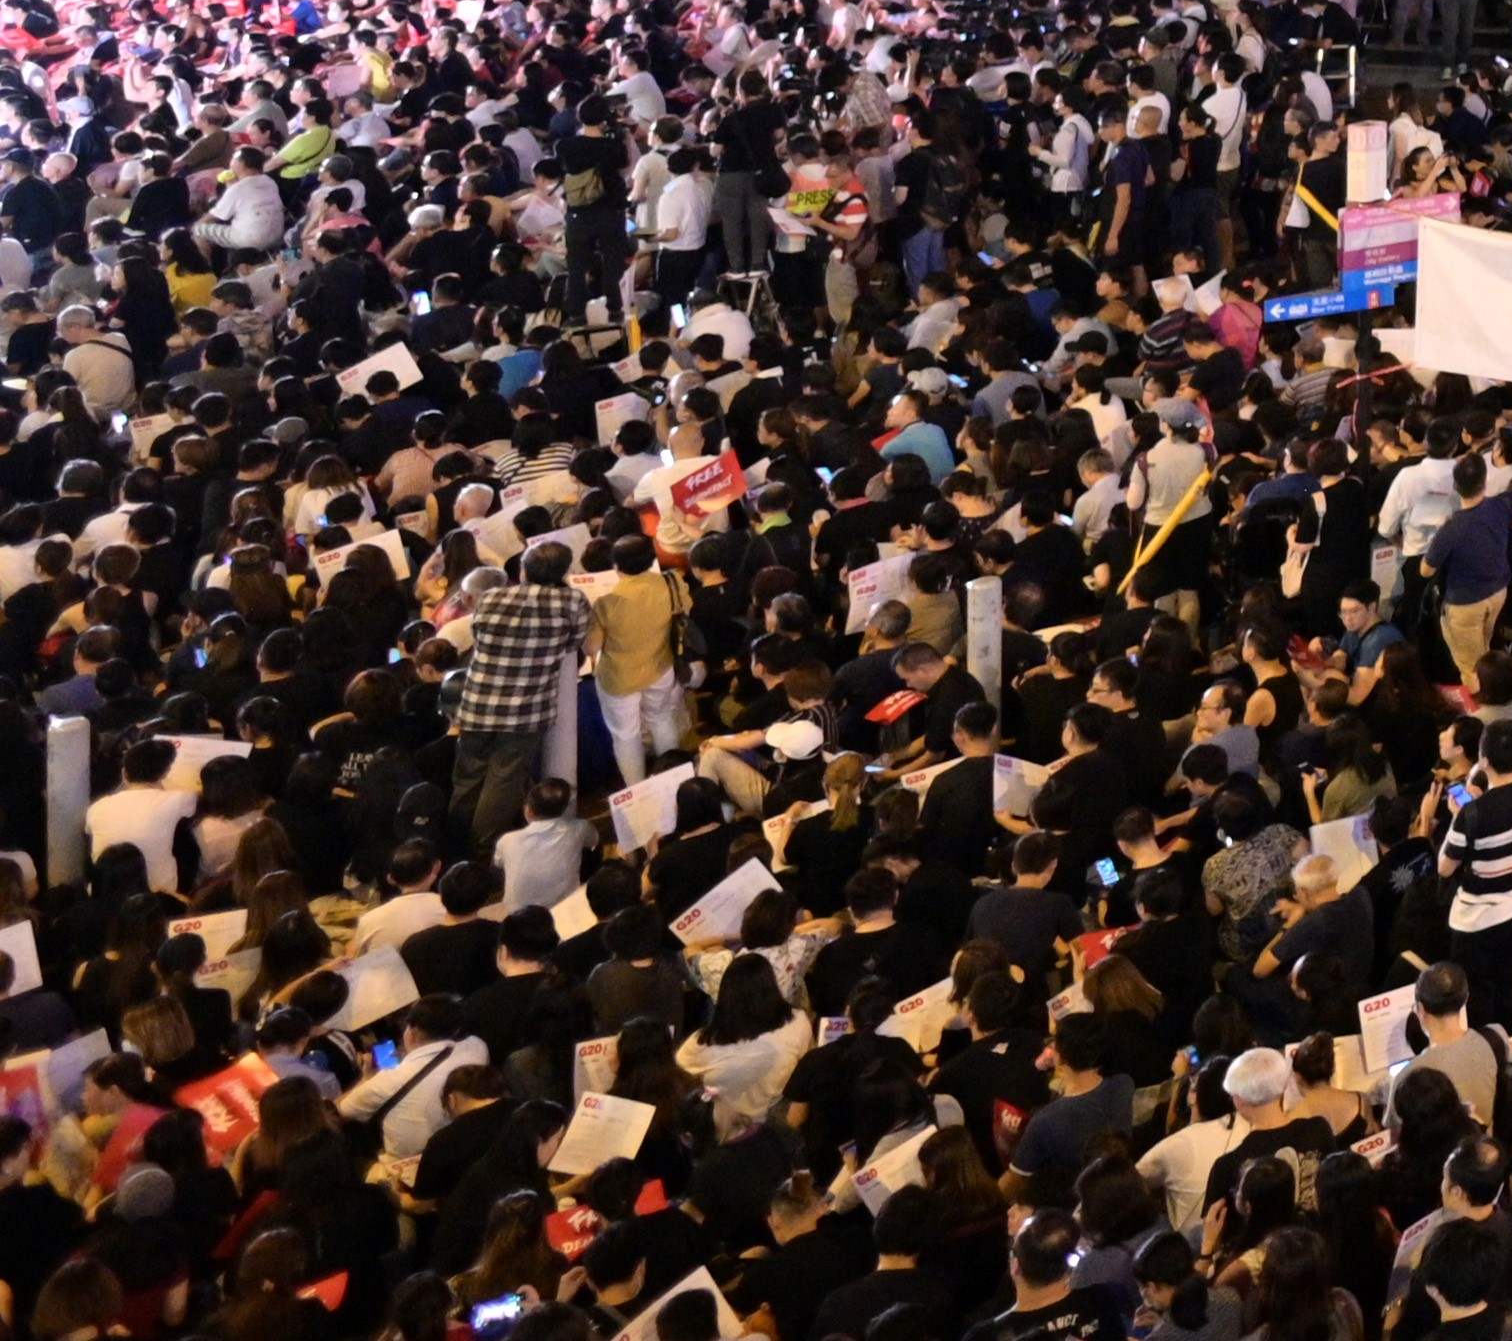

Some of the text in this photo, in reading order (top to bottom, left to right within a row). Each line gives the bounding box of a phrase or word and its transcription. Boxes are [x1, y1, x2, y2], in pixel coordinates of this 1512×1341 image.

[503, 487, 523, 498] G20
[317, 551, 342, 566] G20
[571, 574, 596, 586] G20
[905, 773, 927, 785] G20
[613, 792, 634, 806] G20
[174, 920, 203, 934] G20
[676, 909, 701, 930] G20
[198, 959, 228, 975] G20
[900, 998, 924, 1014] G20
[1364, 997, 1391, 1014] G20
[579, 1043, 602, 1058] G20
[1357, 1138, 1385, 1153] G20
[855, 1168, 879, 1186] G20
